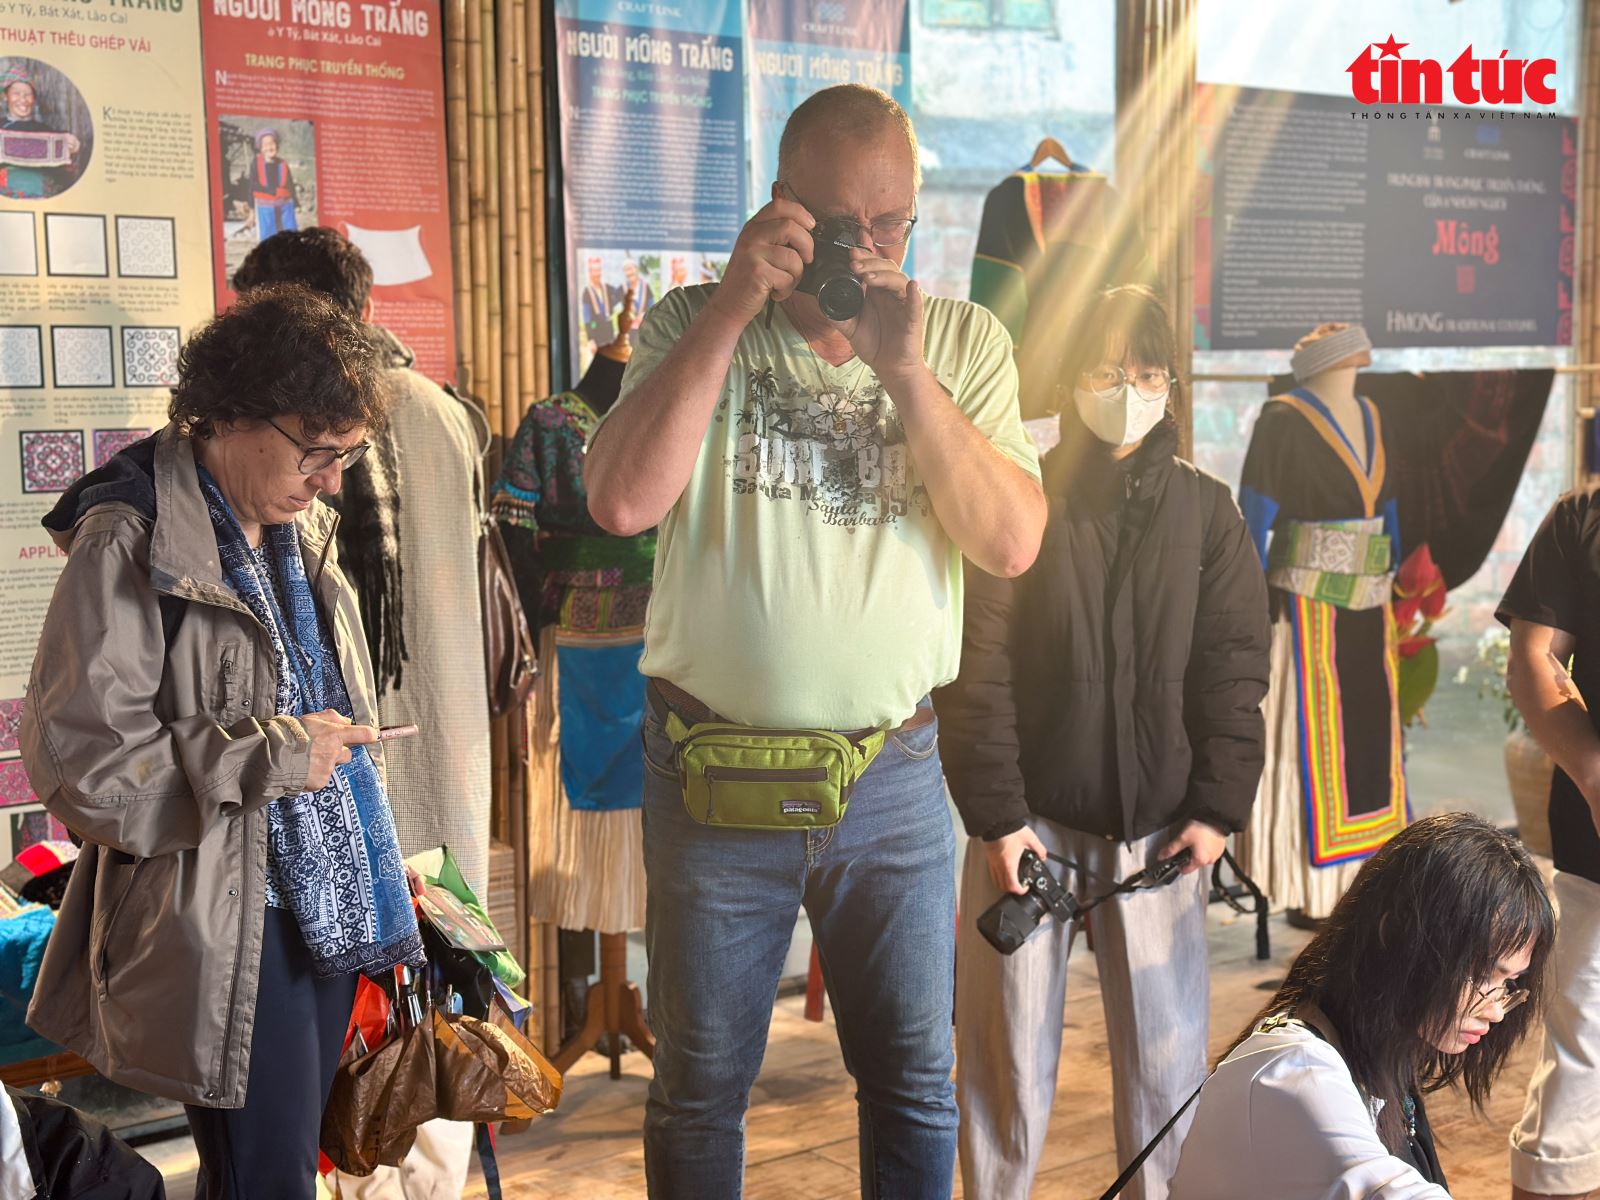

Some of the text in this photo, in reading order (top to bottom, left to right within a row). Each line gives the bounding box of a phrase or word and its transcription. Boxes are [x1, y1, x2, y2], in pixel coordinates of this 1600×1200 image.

[49, 30, 86, 47] THÊU
[89, 34, 125, 50] GHÉP
[245, 52, 286, 70] TRANG
[625, 34, 673, 66] MÔNG
[678, 35, 734, 72] TRẮNG
[808, 501, 860, 516] Santa
[822, 511, 898, 527] Barbara
